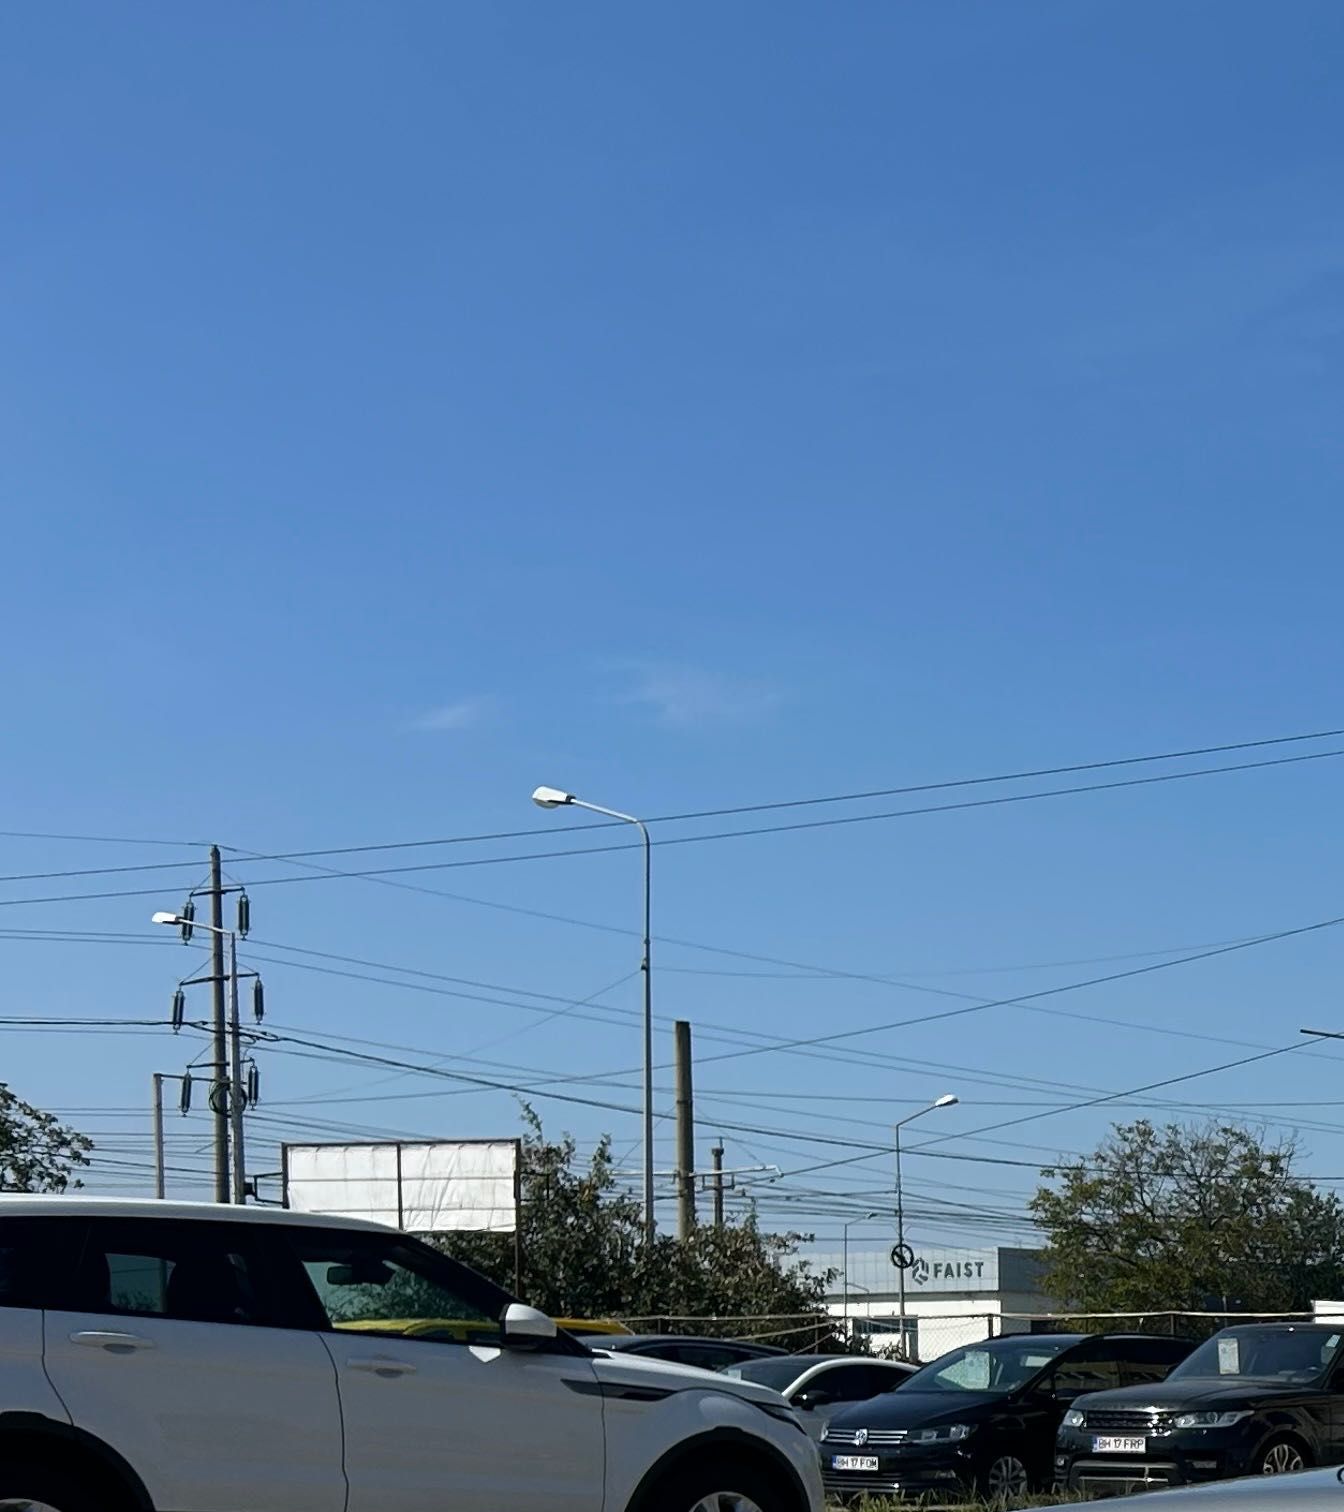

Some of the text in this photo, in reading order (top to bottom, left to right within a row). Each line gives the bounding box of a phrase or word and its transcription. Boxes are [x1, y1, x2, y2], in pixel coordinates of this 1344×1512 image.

[933, 1261, 984, 1279] FAIST
[1098, 1438, 1111, 1449] BH
[1113, 1438, 1122, 1449] 17
